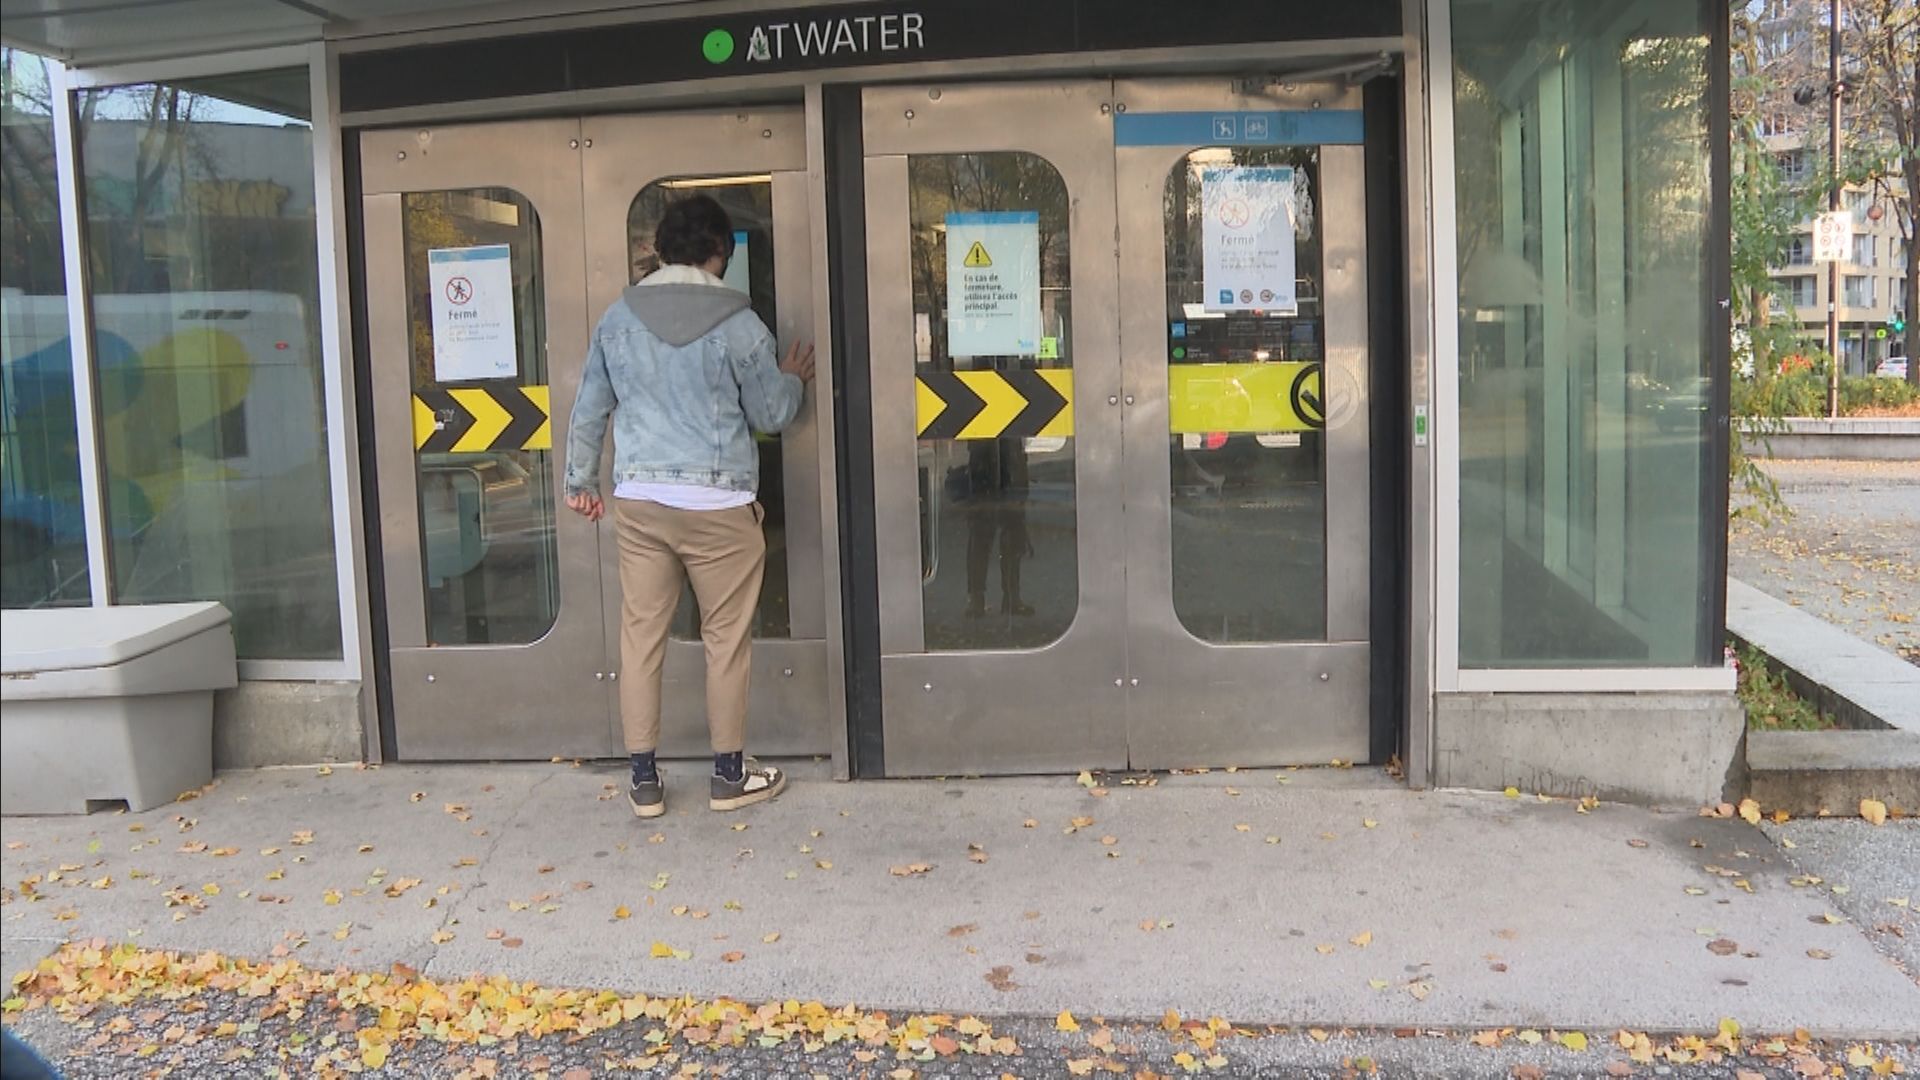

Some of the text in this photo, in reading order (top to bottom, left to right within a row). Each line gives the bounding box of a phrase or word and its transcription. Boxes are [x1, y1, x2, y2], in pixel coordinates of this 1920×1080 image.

[746, 12, 925, 62] ATWATER
[964, 274, 973, 282] En
[989, 273, 998, 281] de
[964, 293, 991, 301] utilisez
[448, 308, 478, 321] Fermé
